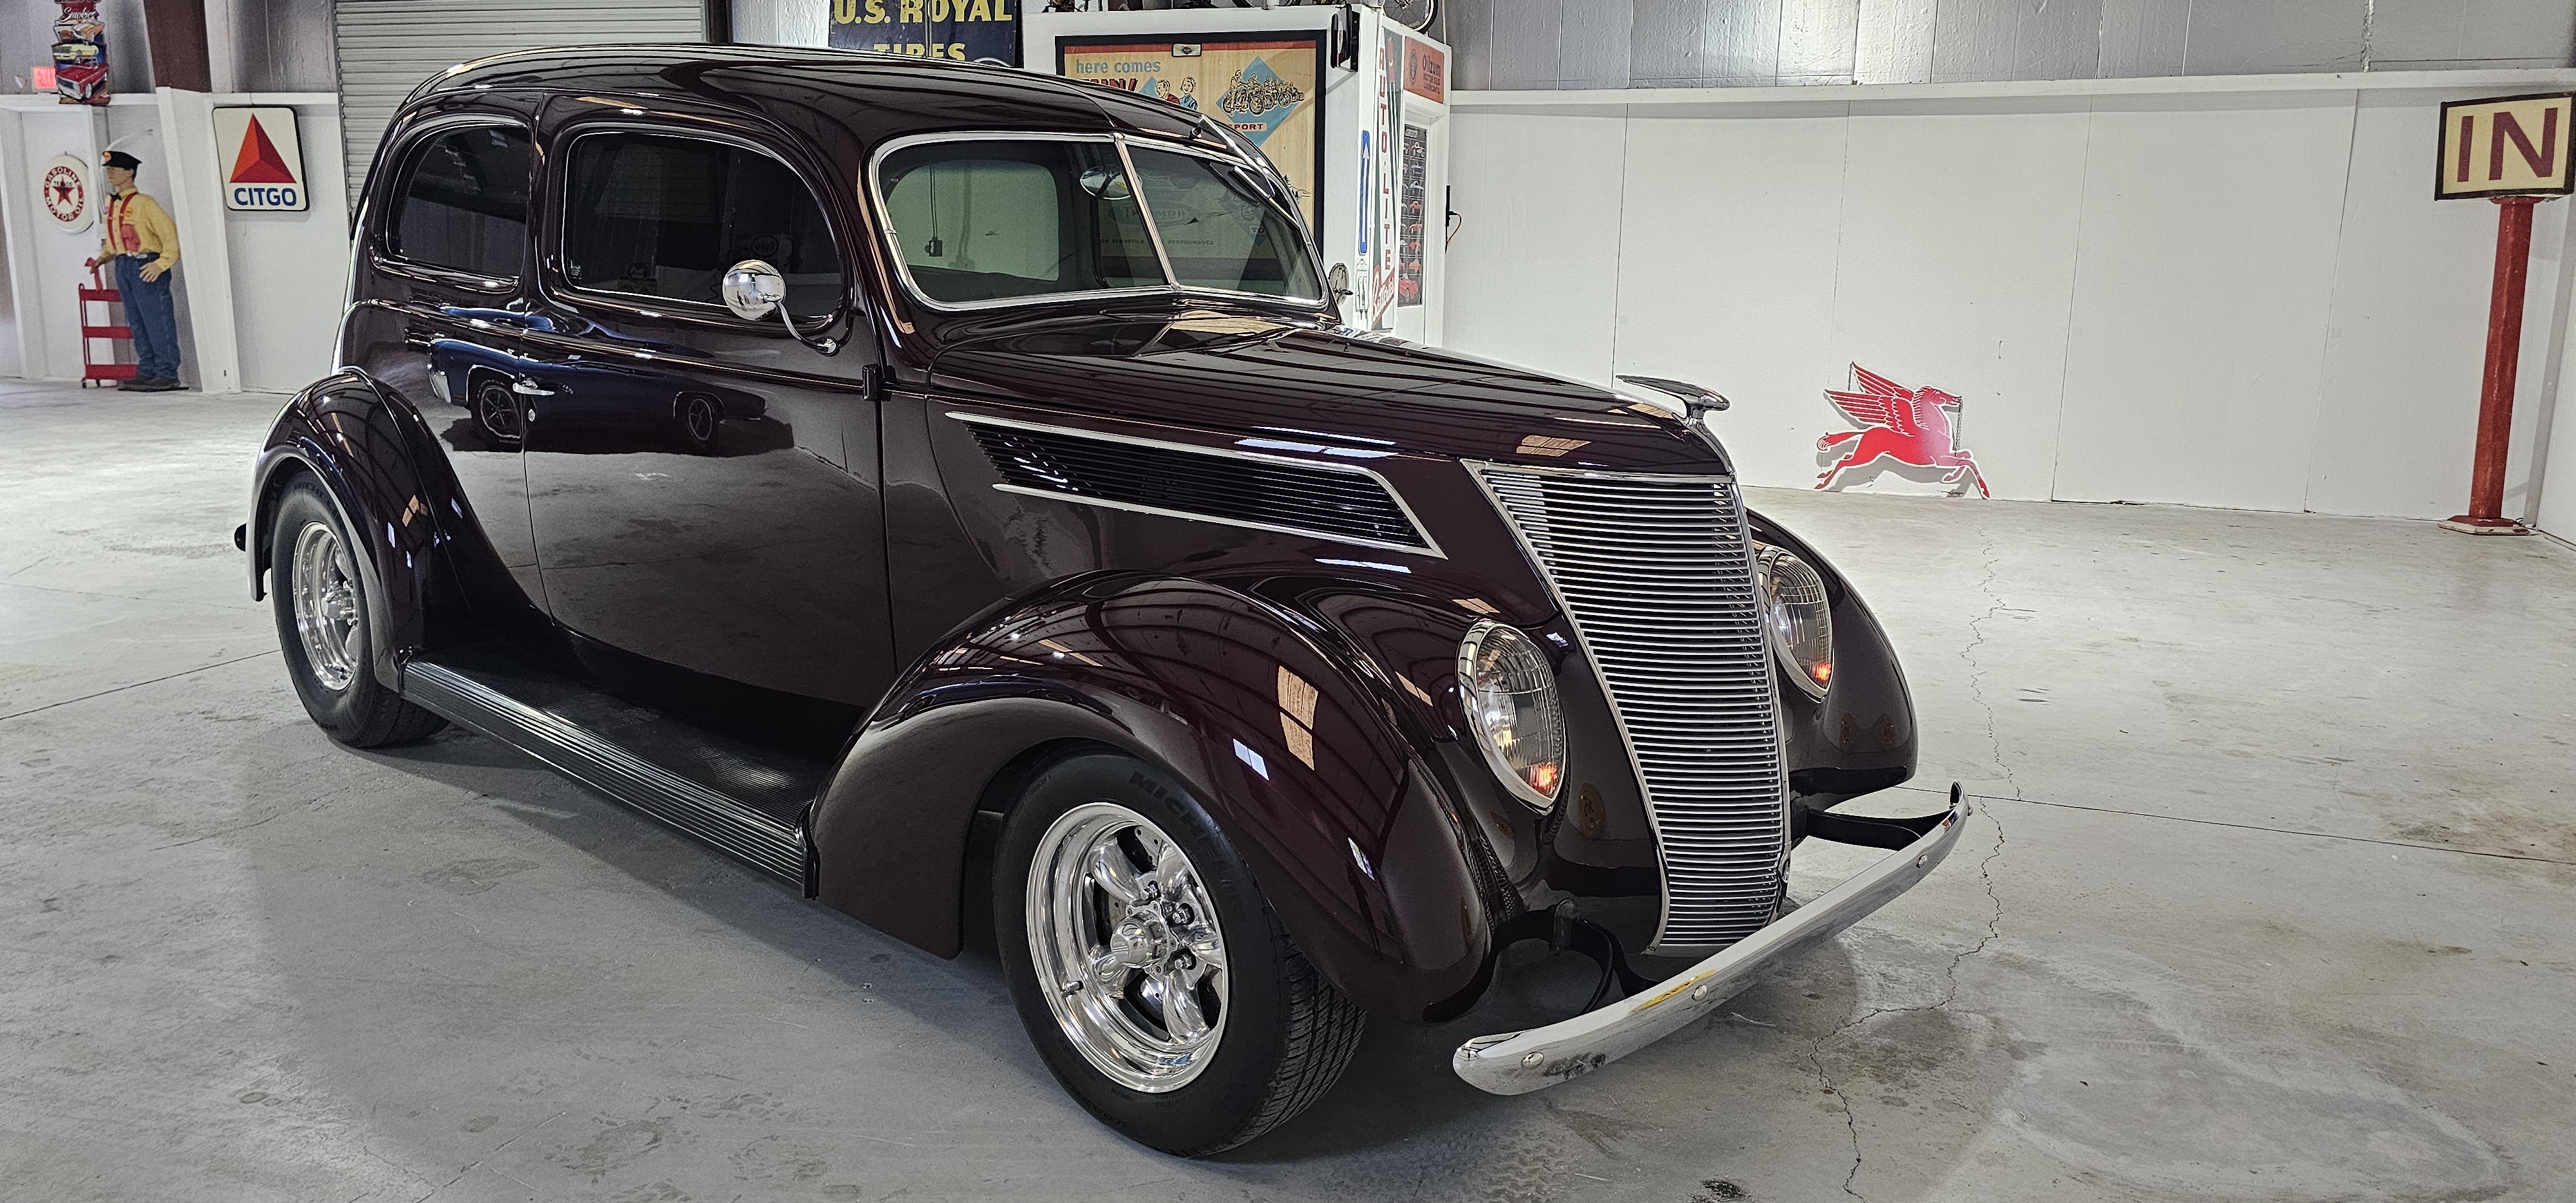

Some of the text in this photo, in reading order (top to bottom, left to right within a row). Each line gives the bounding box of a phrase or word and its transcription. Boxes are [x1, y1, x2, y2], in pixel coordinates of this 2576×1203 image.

[1076, 59, 1161, 73] here comes
[2457, 108, 2558, 182] IN
[234, 187, 297, 206] CITGO
